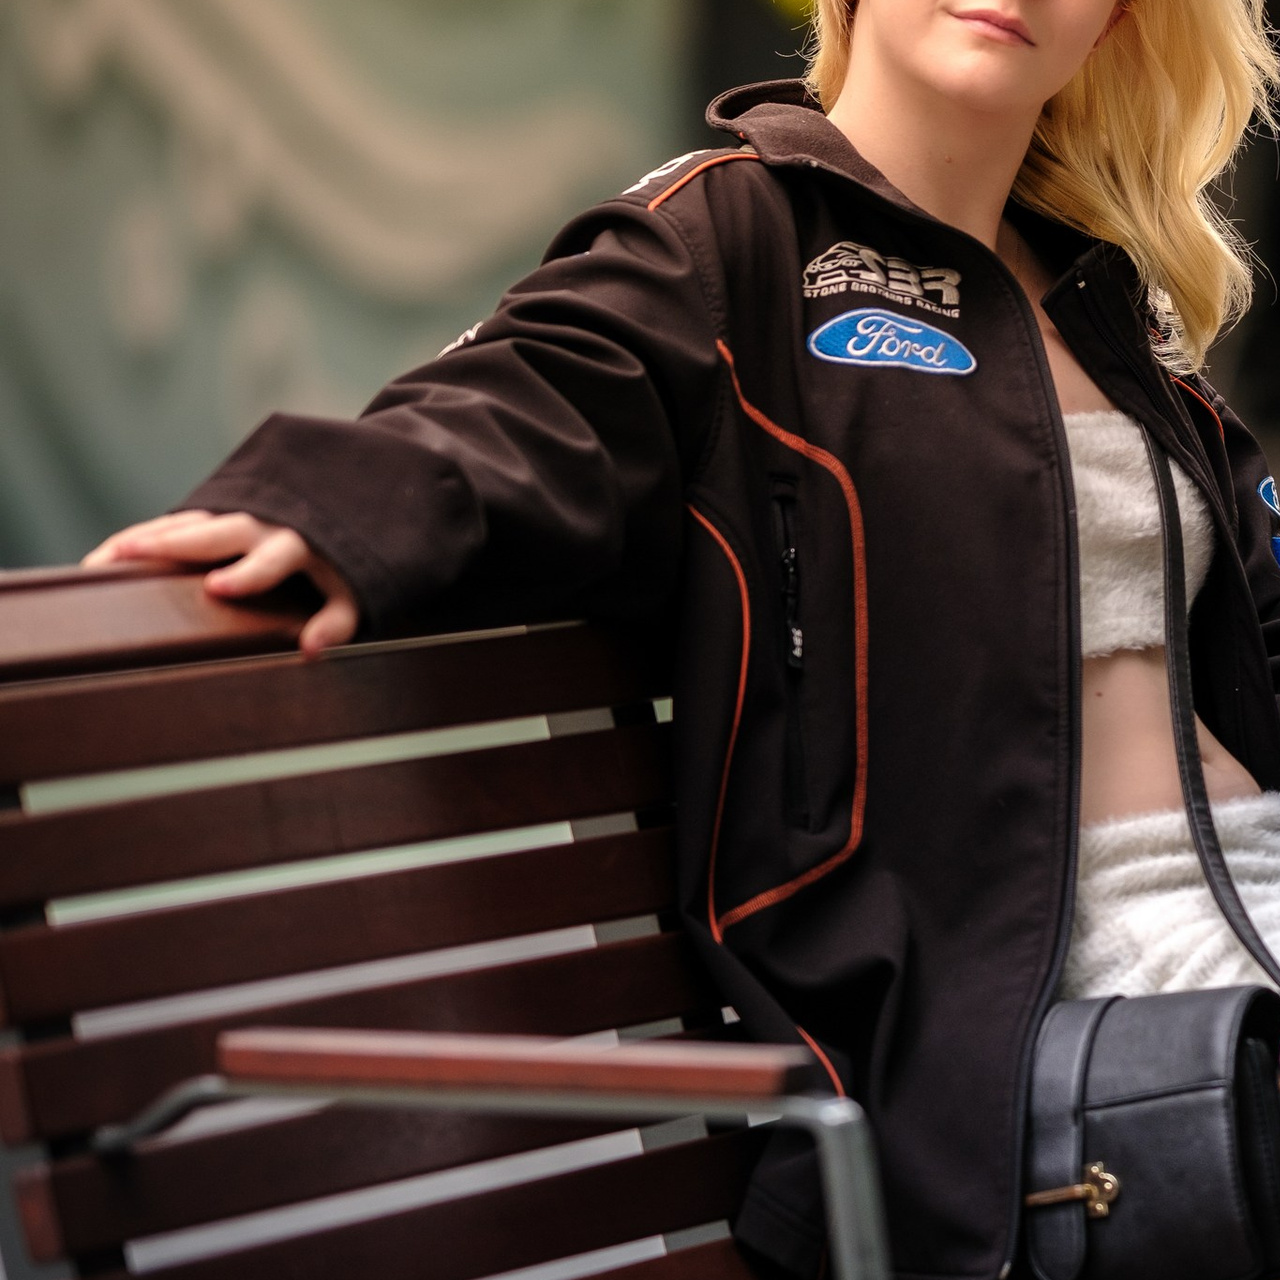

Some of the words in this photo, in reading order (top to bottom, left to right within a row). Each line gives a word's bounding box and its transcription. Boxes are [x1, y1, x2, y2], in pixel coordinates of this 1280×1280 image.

[803, 282, 847, 298] STONE
[851, 282, 912, 305] BROTHERS
[916, 299, 960, 318] RACING
[846, 316, 948, 366] Ford
